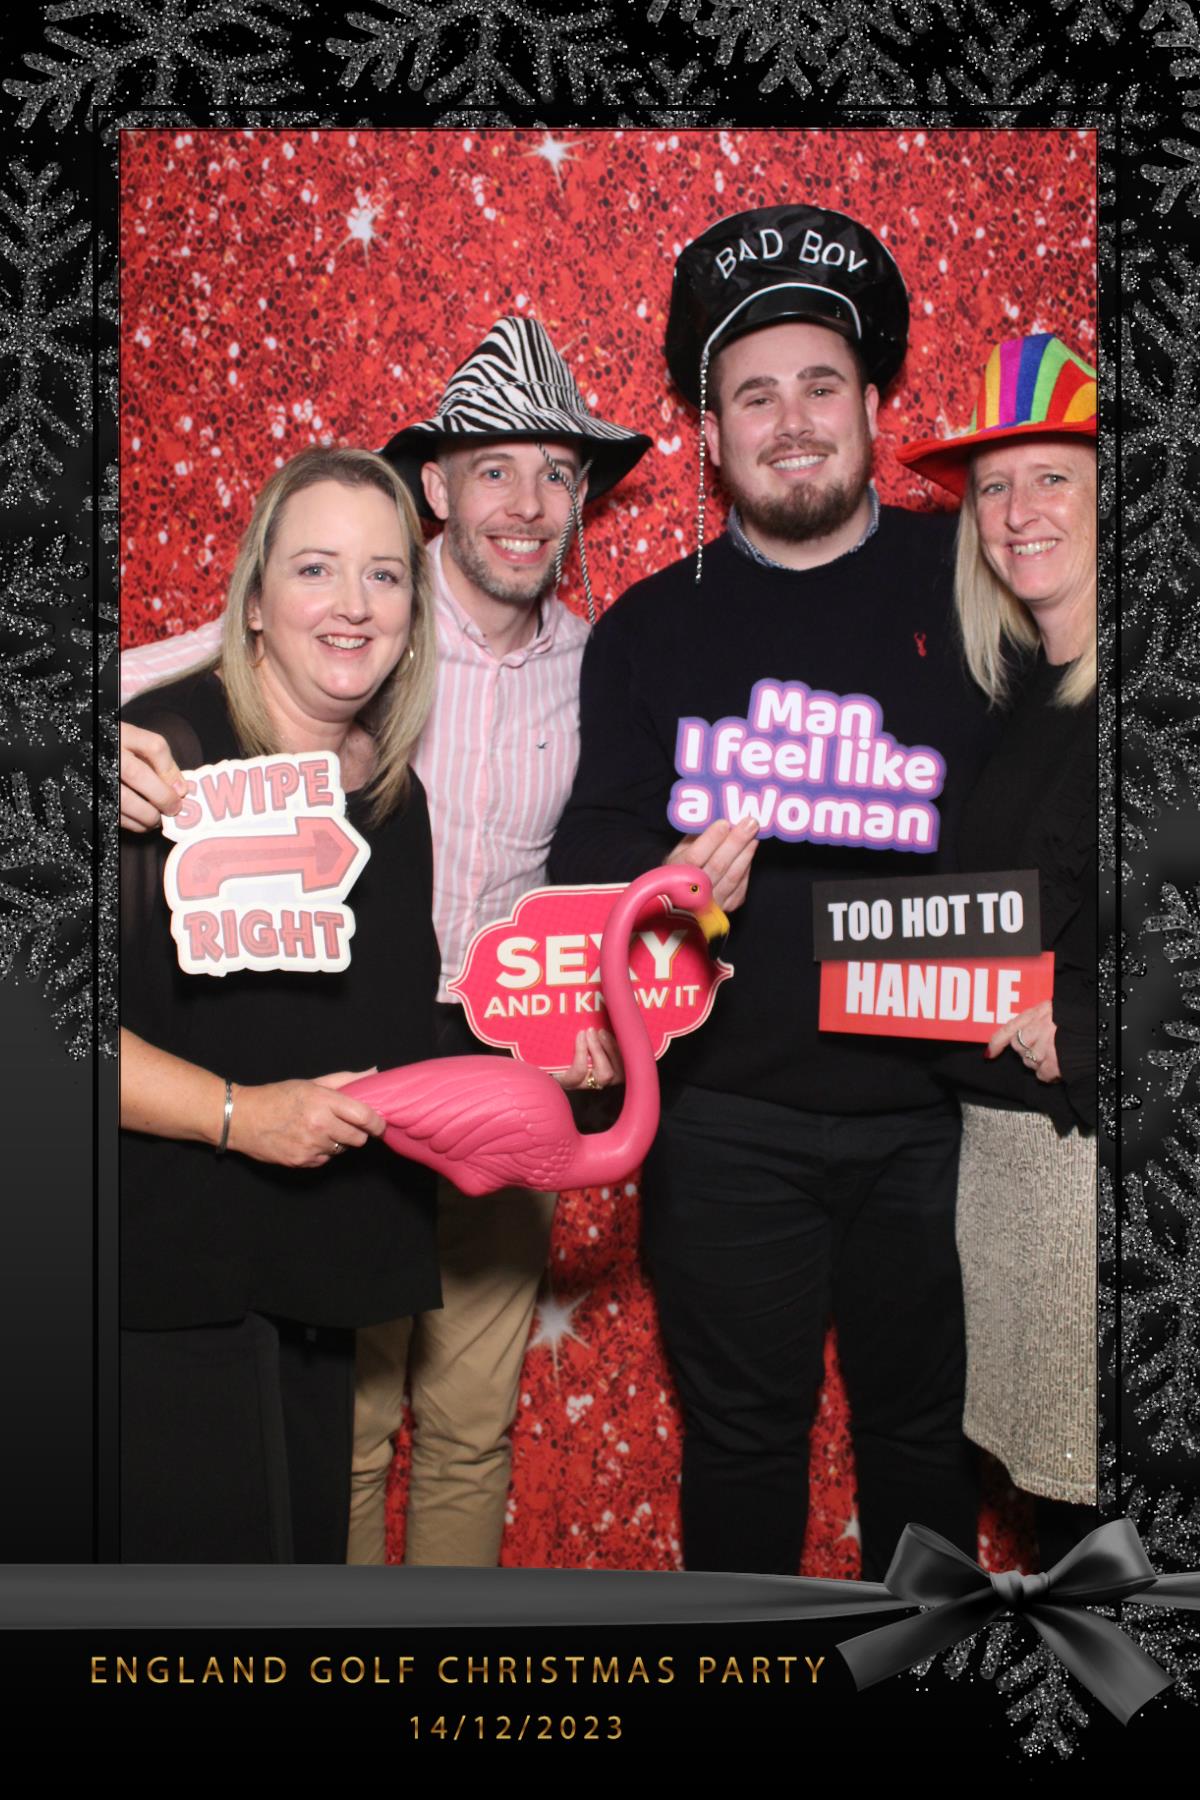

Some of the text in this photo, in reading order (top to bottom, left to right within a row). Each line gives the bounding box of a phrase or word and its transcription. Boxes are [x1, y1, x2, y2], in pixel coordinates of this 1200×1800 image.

[715, 228, 784, 280] BAD
[756, 688, 873, 739] Man
[684, 727, 937, 790] I feel like
[173, 759, 335, 830] SWIPE
[677, 784, 930, 843] a Woman
[182, 908, 346, 963] RIGHT
[827, 890, 1024, 942] TOO HOT TO
[483, 993, 552, 1019] AND
[559, 993, 566, 1014] I
[675, 984, 701, 1008] IT
[845, 960, 1022, 1025] HANDLE
